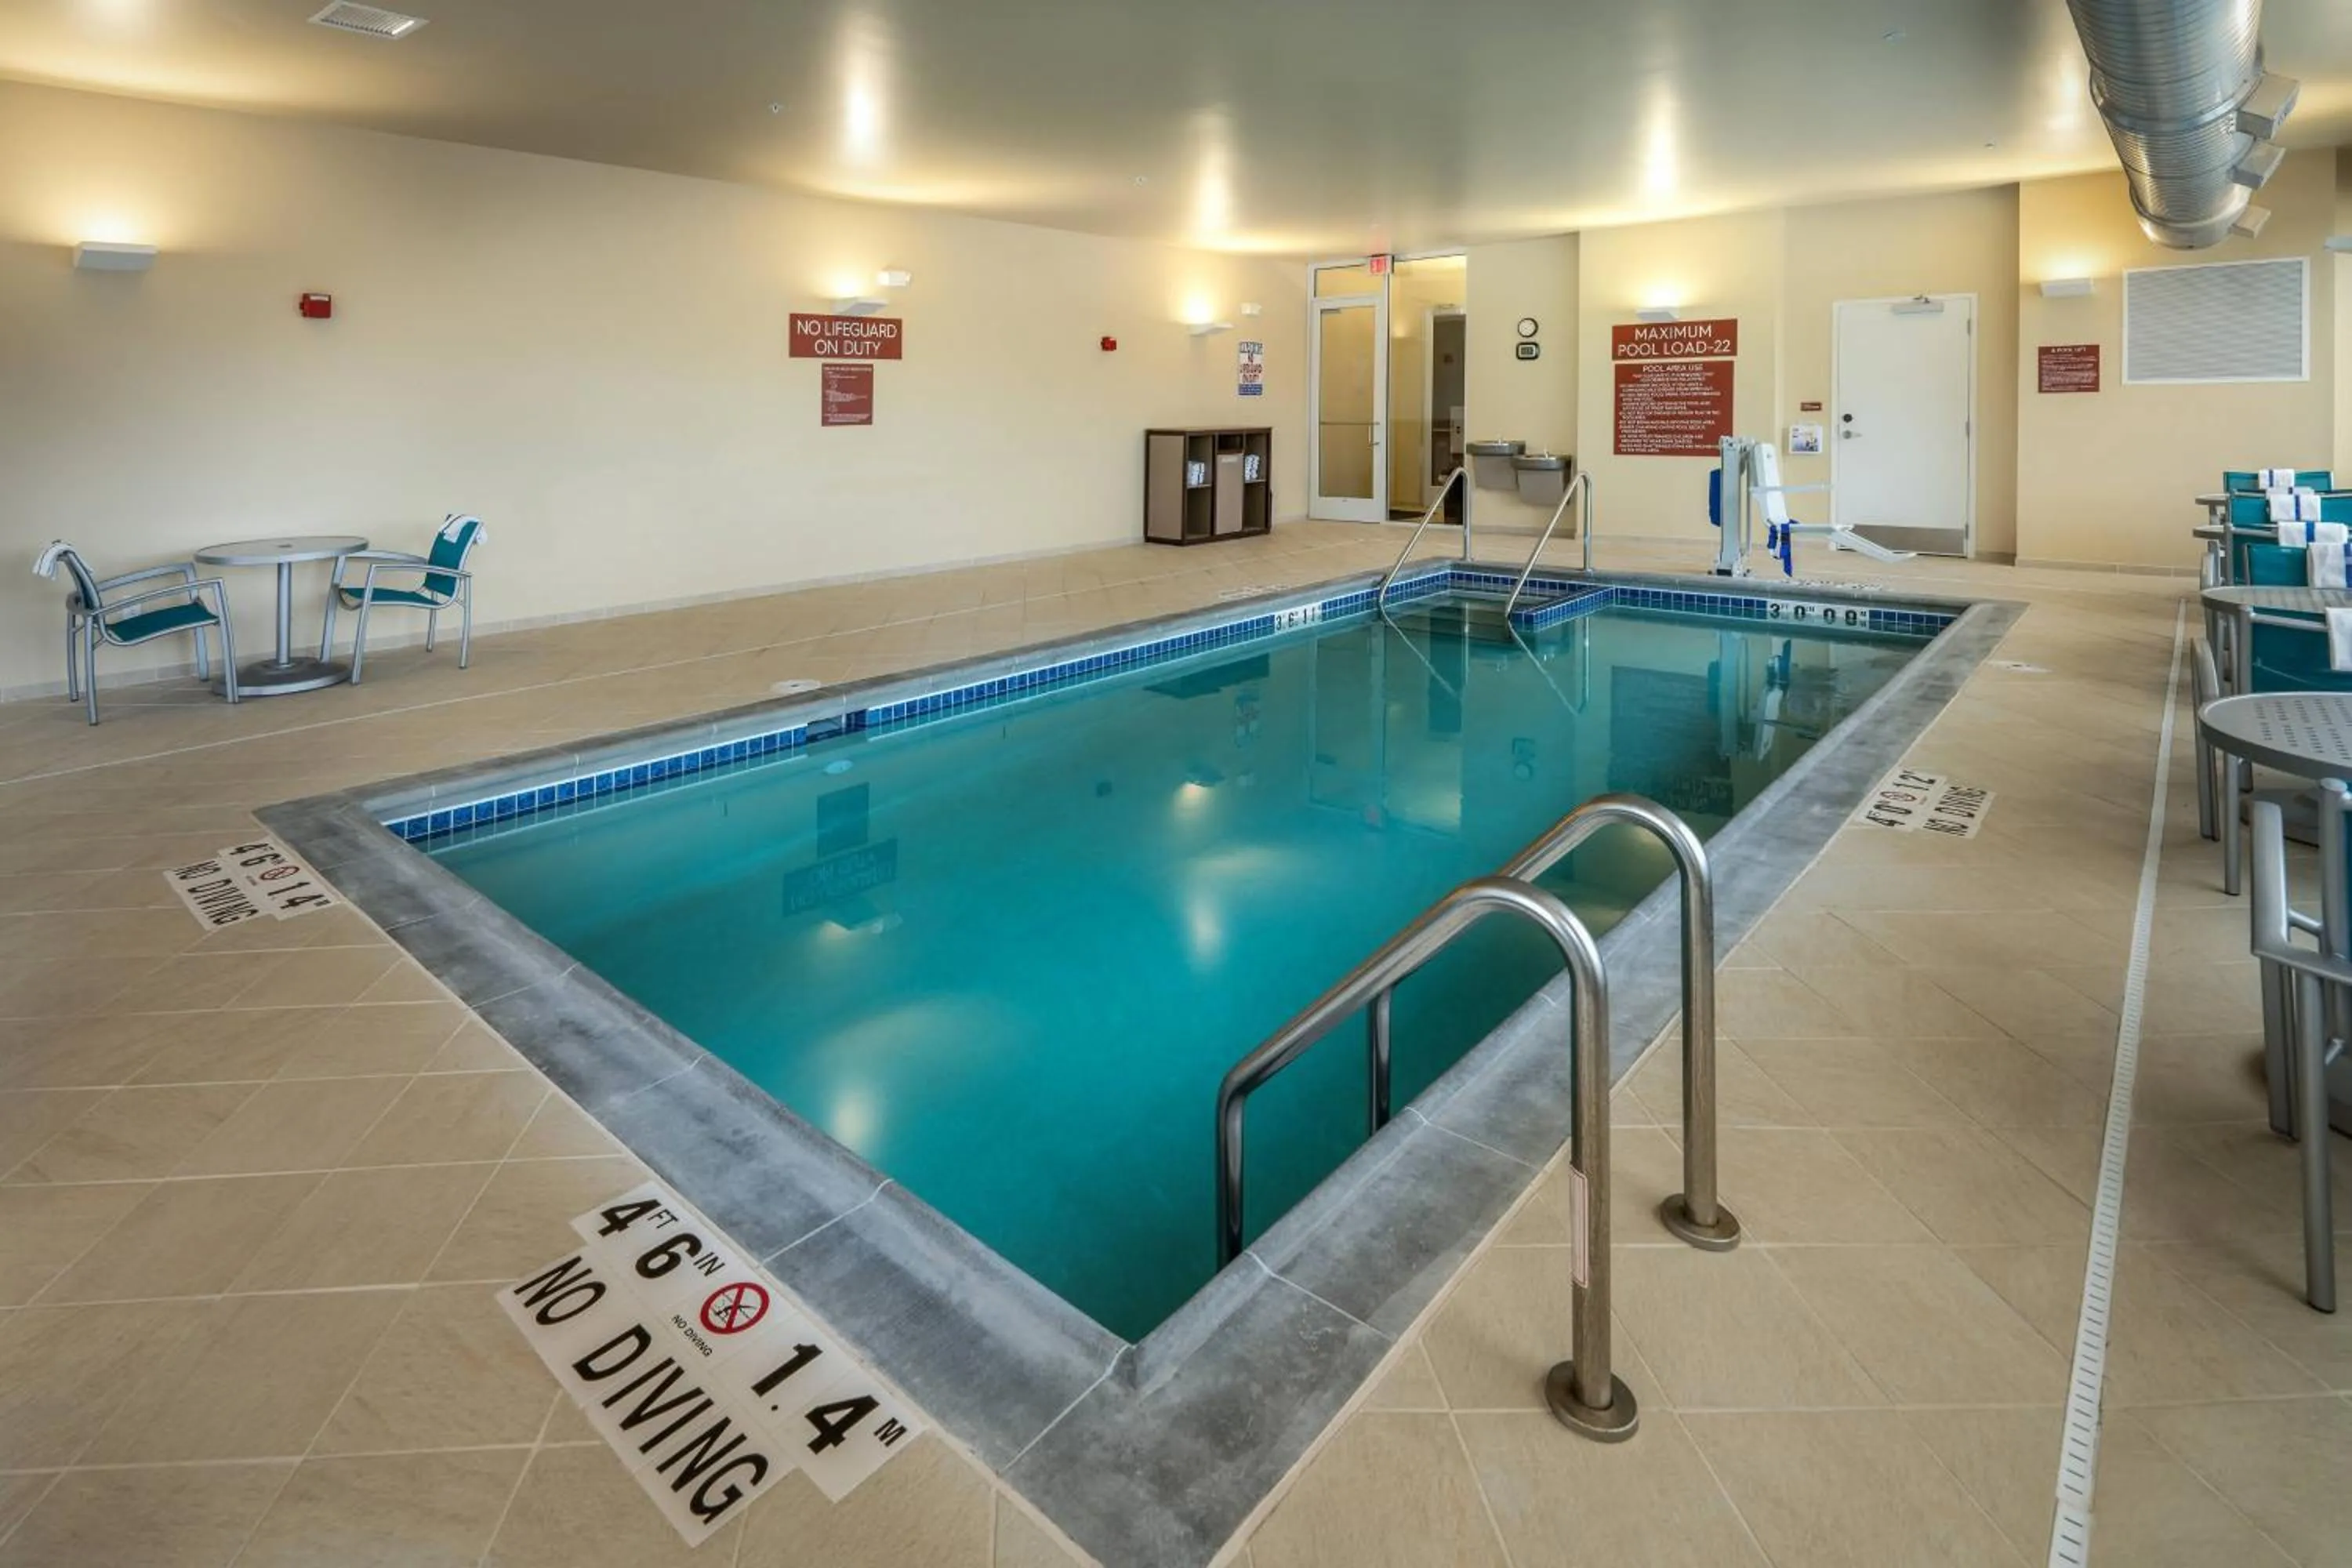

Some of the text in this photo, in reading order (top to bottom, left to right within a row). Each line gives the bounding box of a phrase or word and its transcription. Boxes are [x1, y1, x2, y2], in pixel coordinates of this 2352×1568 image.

[797, 320, 898, 338] NO LIFEGUARD
[1635, 324, 1712, 340] MAXIMUM
[815, 339, 881, 355] ON DUTY
[1618, 339, 1731, 357] POOL LOAD-22
[1769, 603, 1780, 619] 3
[230, 843, 269, 855] 4
[240, 853, 281, 867] 6
[173, 860, 260, 926] NO DIVING
[597, 1199, 662, 1237] 4
[647, 1209, 679, 1229] FT
[635, 1232, 702, 1279] 6
[693, 1252, 725, 1276] IN
[671, 1315, 713, 1357] NO DIVING
[514, 1256, 769, 1525] NO DIVING
[873, 1417, 908, 1447] M
